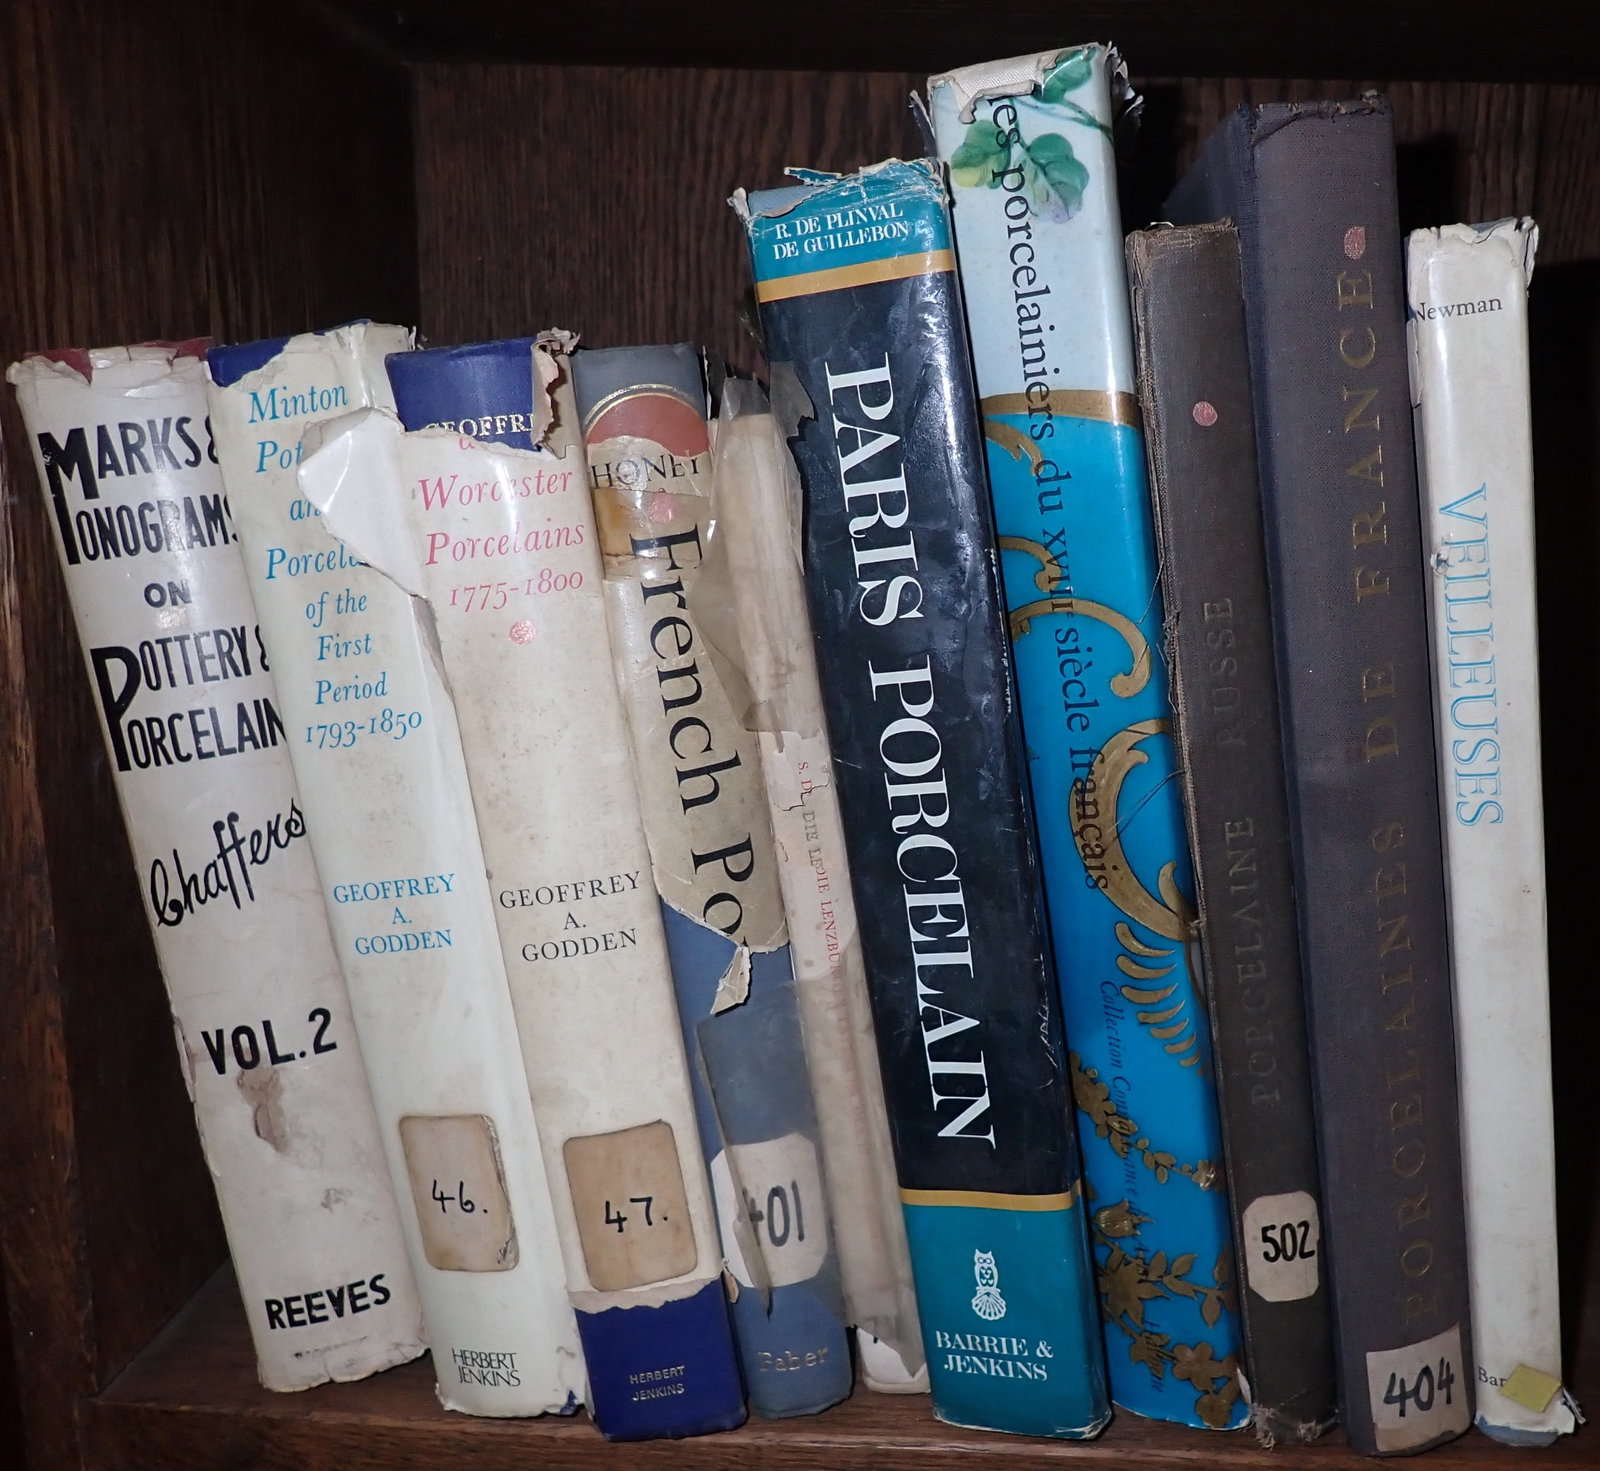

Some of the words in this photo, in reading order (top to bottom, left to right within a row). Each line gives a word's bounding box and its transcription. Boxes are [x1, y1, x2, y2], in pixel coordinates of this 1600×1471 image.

[773, 241, 799, 259] DE
[803, 219, 910, 254] GUILLEBON
[776, 222, 792, 239] R.
[796, 217, 821, 236] DE
[827, 202, 903, 230] PLINVAL
[991, 163, 1059, 440] porcelainiers
[1416, 298, 1504, 321] Newman
[248, 385, 349, 424] Minton
[1336, 271, 1390, 604] FRANCE
[37, 416, 202, 500] MARKS
[825, 351, 925, 627] PARIS
[1034, 459, 1072, 515] du
[425, 517, 585, 566] Porcelains
[143, 582, 192, 609] ON
[304, 592, 329, 627] of
[335, 588, 368, 616] the
[450, 567, 583, 613] 1775-1800
[316, 632, 373, 661] First
[1438, 482, 1504, 827] VEILLEUSES
[89, 625, 252, 745] POTTERY
[314, 672, 389, 706] Period
[1054, 628, 1100, 732] siècle
[305, 710, 423, 750] 1793-1850
[628, 522, 743, 815] French
[691, 832, 755, 940] Po
[1363, 664, 1400, 762] DE
[1069, 747, 1118, 890] français
[150, 797, 307, 927] Chaffers
[332, 872, 456, 904] GEOFFREY
[499, 870, 641, 909] GEOFFREY
[868, 655, 998, 1150] PORCELAIN
[391, 906, 413, 925] A.
[563, 912, 587, 930] A.
[353, 929, 454, 956] GODDEN
[521, 928, 637, 962] GODDEN
[1100, 980, 1126, 1069] Collection
[1372, 820, 1437, 1325] PORCELAINES
[1261, 1220, 1316, 1263] 502
[264, 1273, 392, 1330] REEVES
[452, 1347, 518, 1370] HERBERT
[758, 1346, 828, 1372] Faber
[935, 1330, 1029, 1357] BARRIE
[1036, 1340, 1054, 1358] &
[458, 1364, 521, 1388] JENKINS
[629, 1365, 686, 1386] HERBERT
[943, 1354, 1048, 1382] JENKINS
[1383, 1356, 1455, 1418] 404
[632, 1382, 686, 1402] JENKINS
